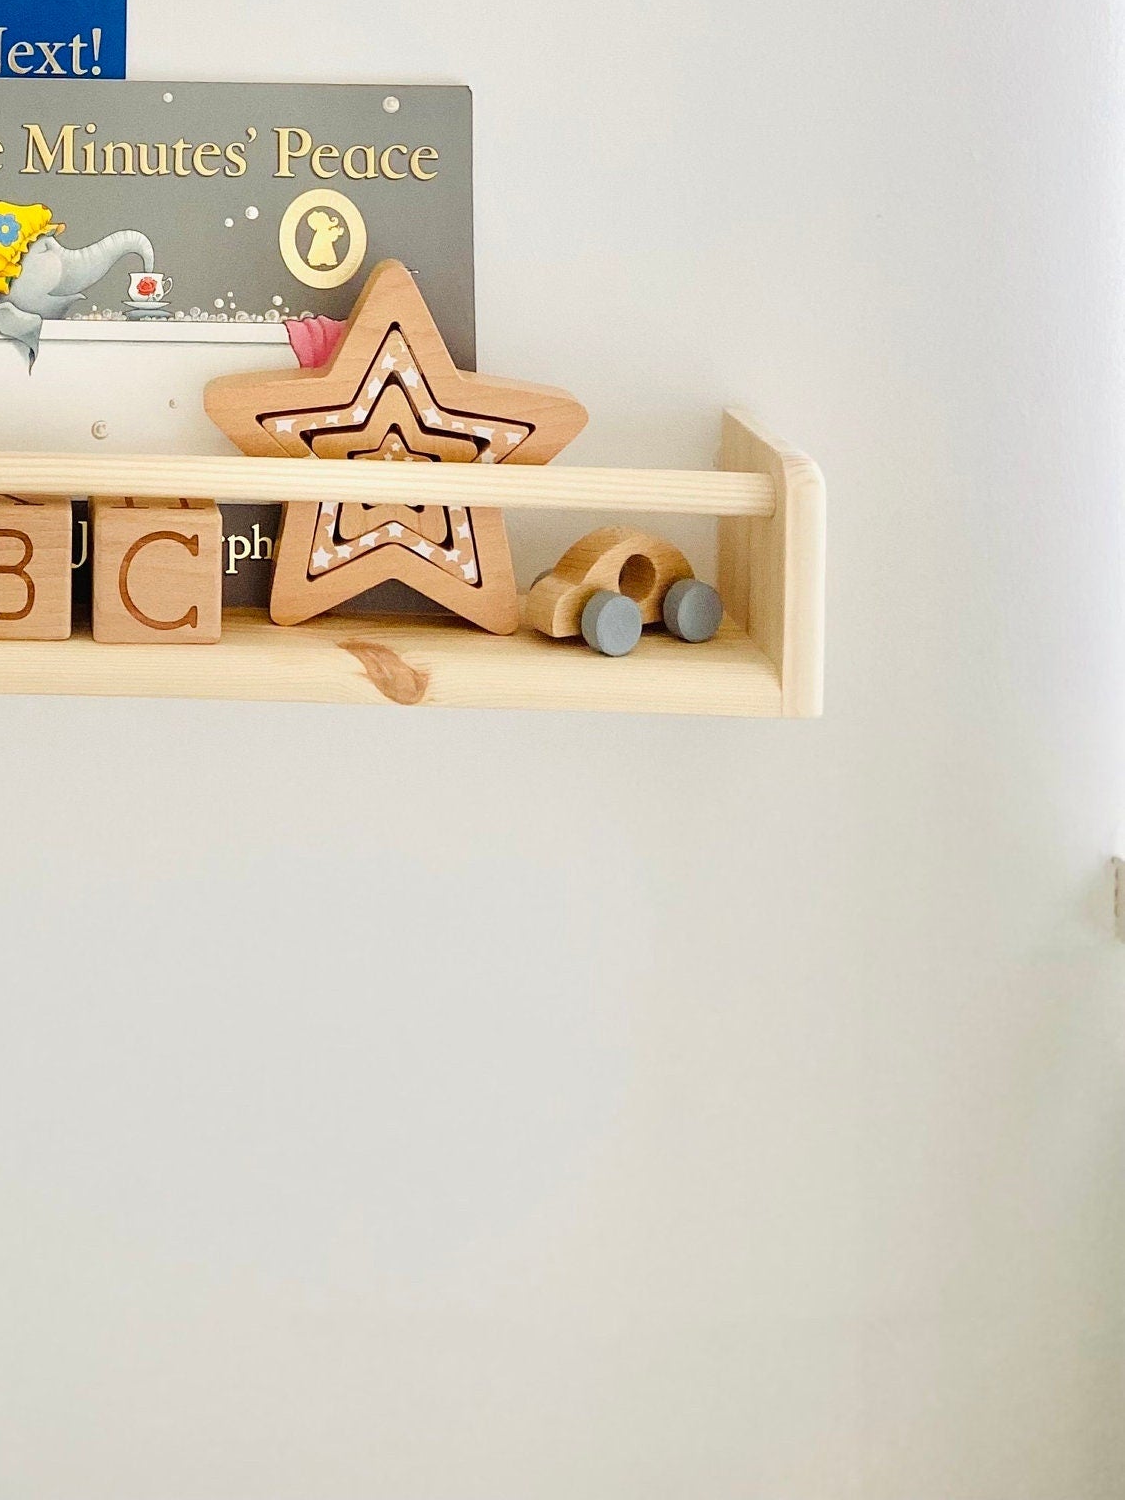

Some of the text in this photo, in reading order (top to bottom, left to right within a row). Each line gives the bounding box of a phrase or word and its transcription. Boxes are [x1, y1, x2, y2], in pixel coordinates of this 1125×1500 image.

[18, 123, 257, 178] Minutes'
[271, 127, 438, 181] Peace
[118, 530, 199, 631] C
